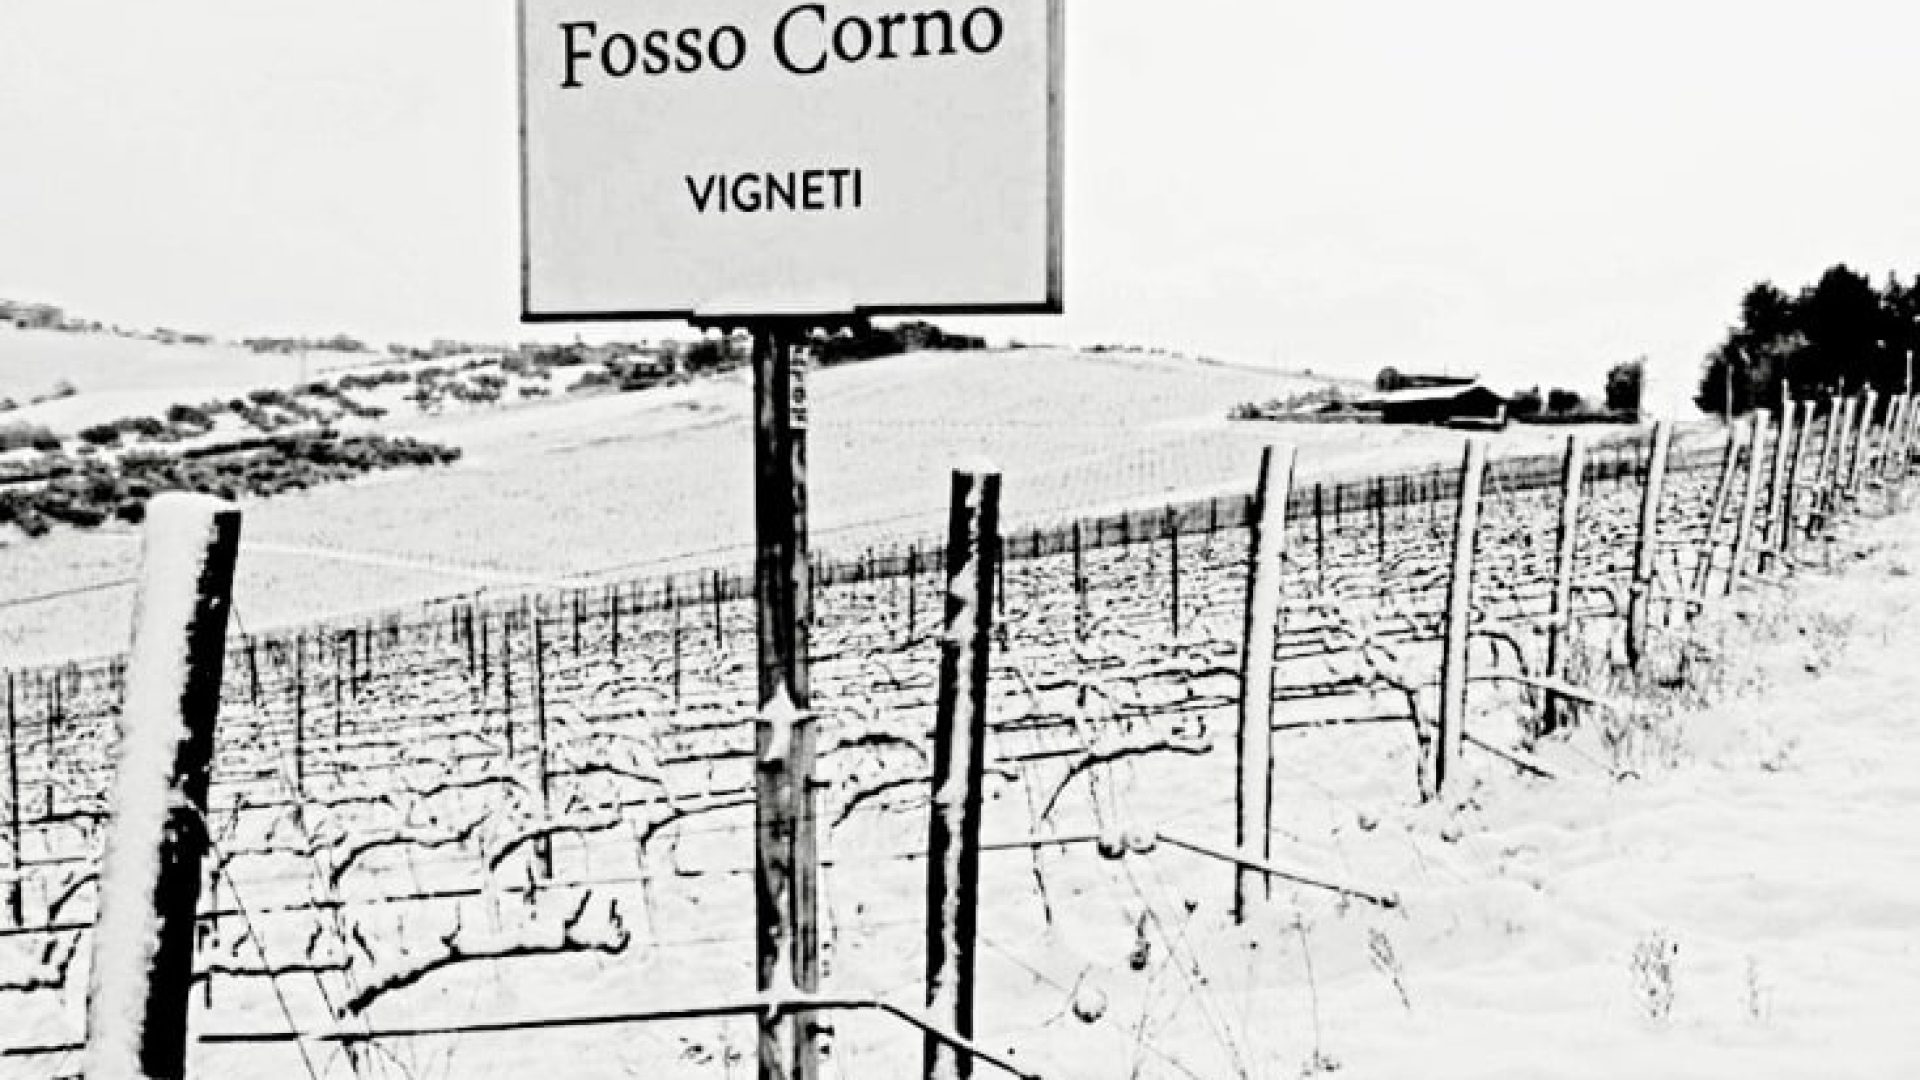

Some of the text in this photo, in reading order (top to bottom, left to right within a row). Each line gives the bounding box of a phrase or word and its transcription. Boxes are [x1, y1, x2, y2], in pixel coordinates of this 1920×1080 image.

[559, 3, 1004, 89] Fosso Corno
[685, 169, 863, 213] VIGNETI
